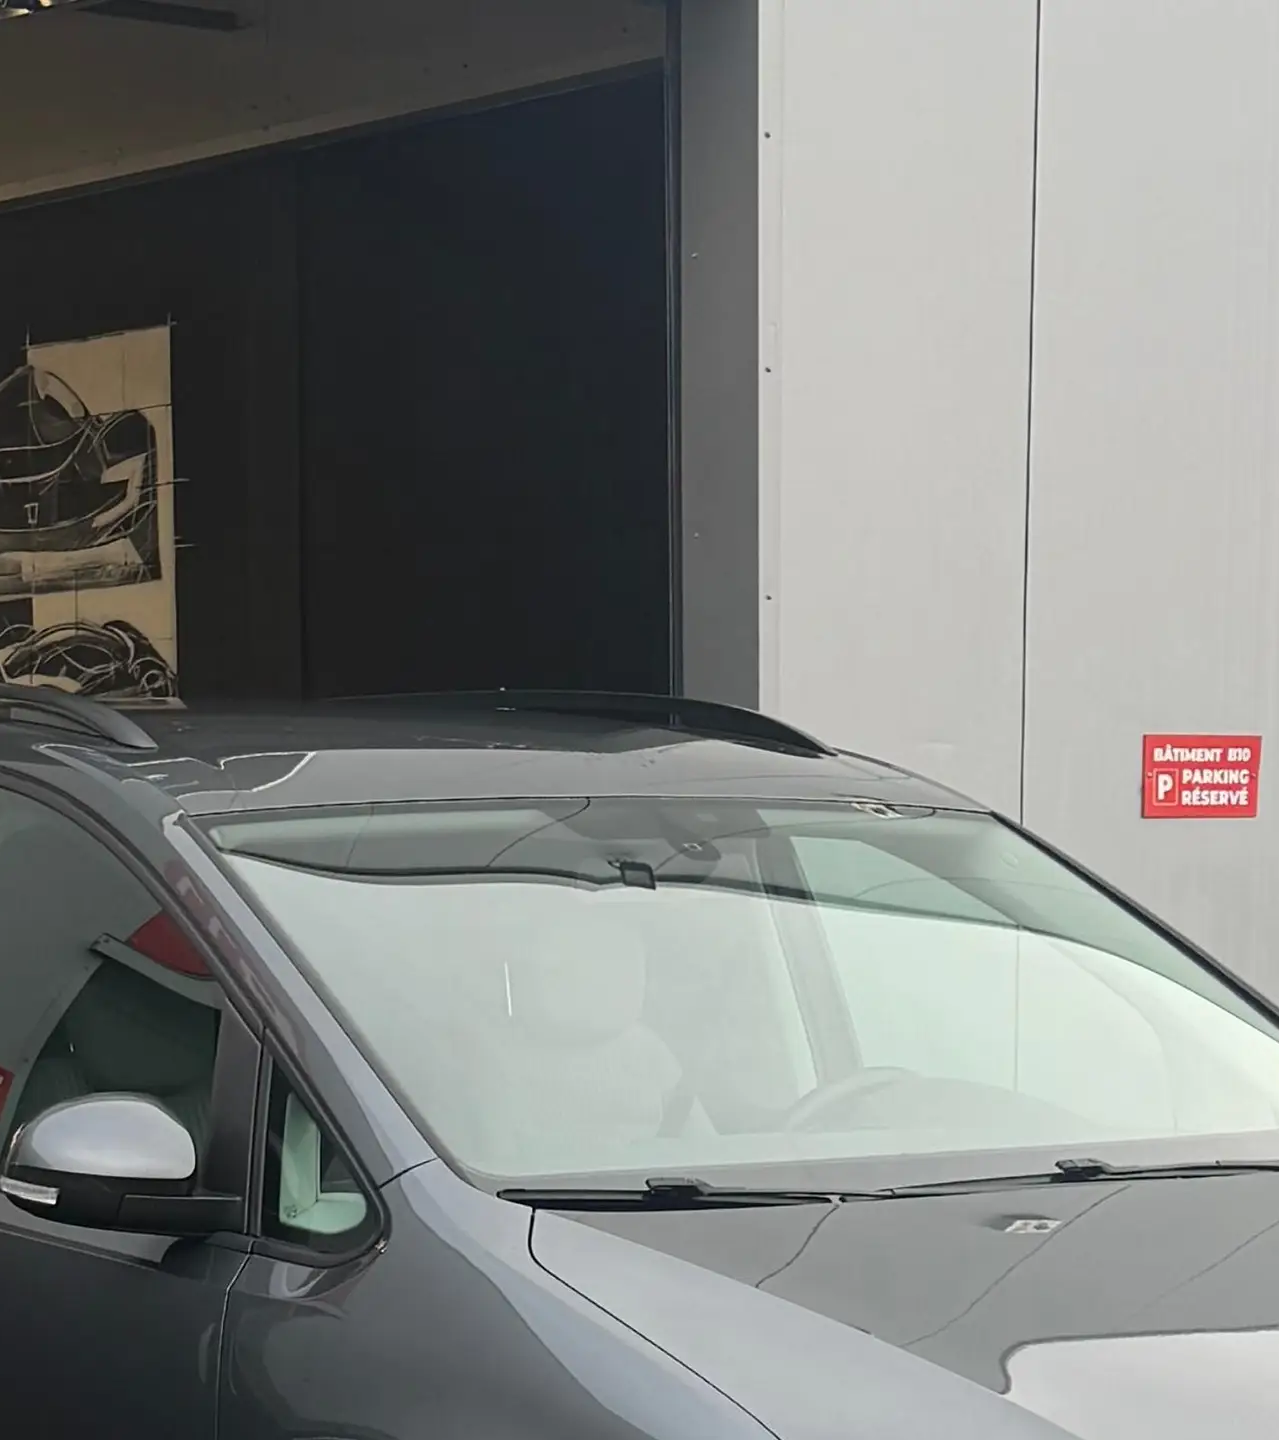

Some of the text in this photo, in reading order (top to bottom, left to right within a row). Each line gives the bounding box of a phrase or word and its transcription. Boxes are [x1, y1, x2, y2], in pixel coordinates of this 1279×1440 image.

[1153, 743, 1224, 762] BÂTIMENT
[1181, 768, 1250, 784] PARKING
[1157, 774, 1173, 800] P
[1181, 786, 1249, 805] RÉSERVÉ
